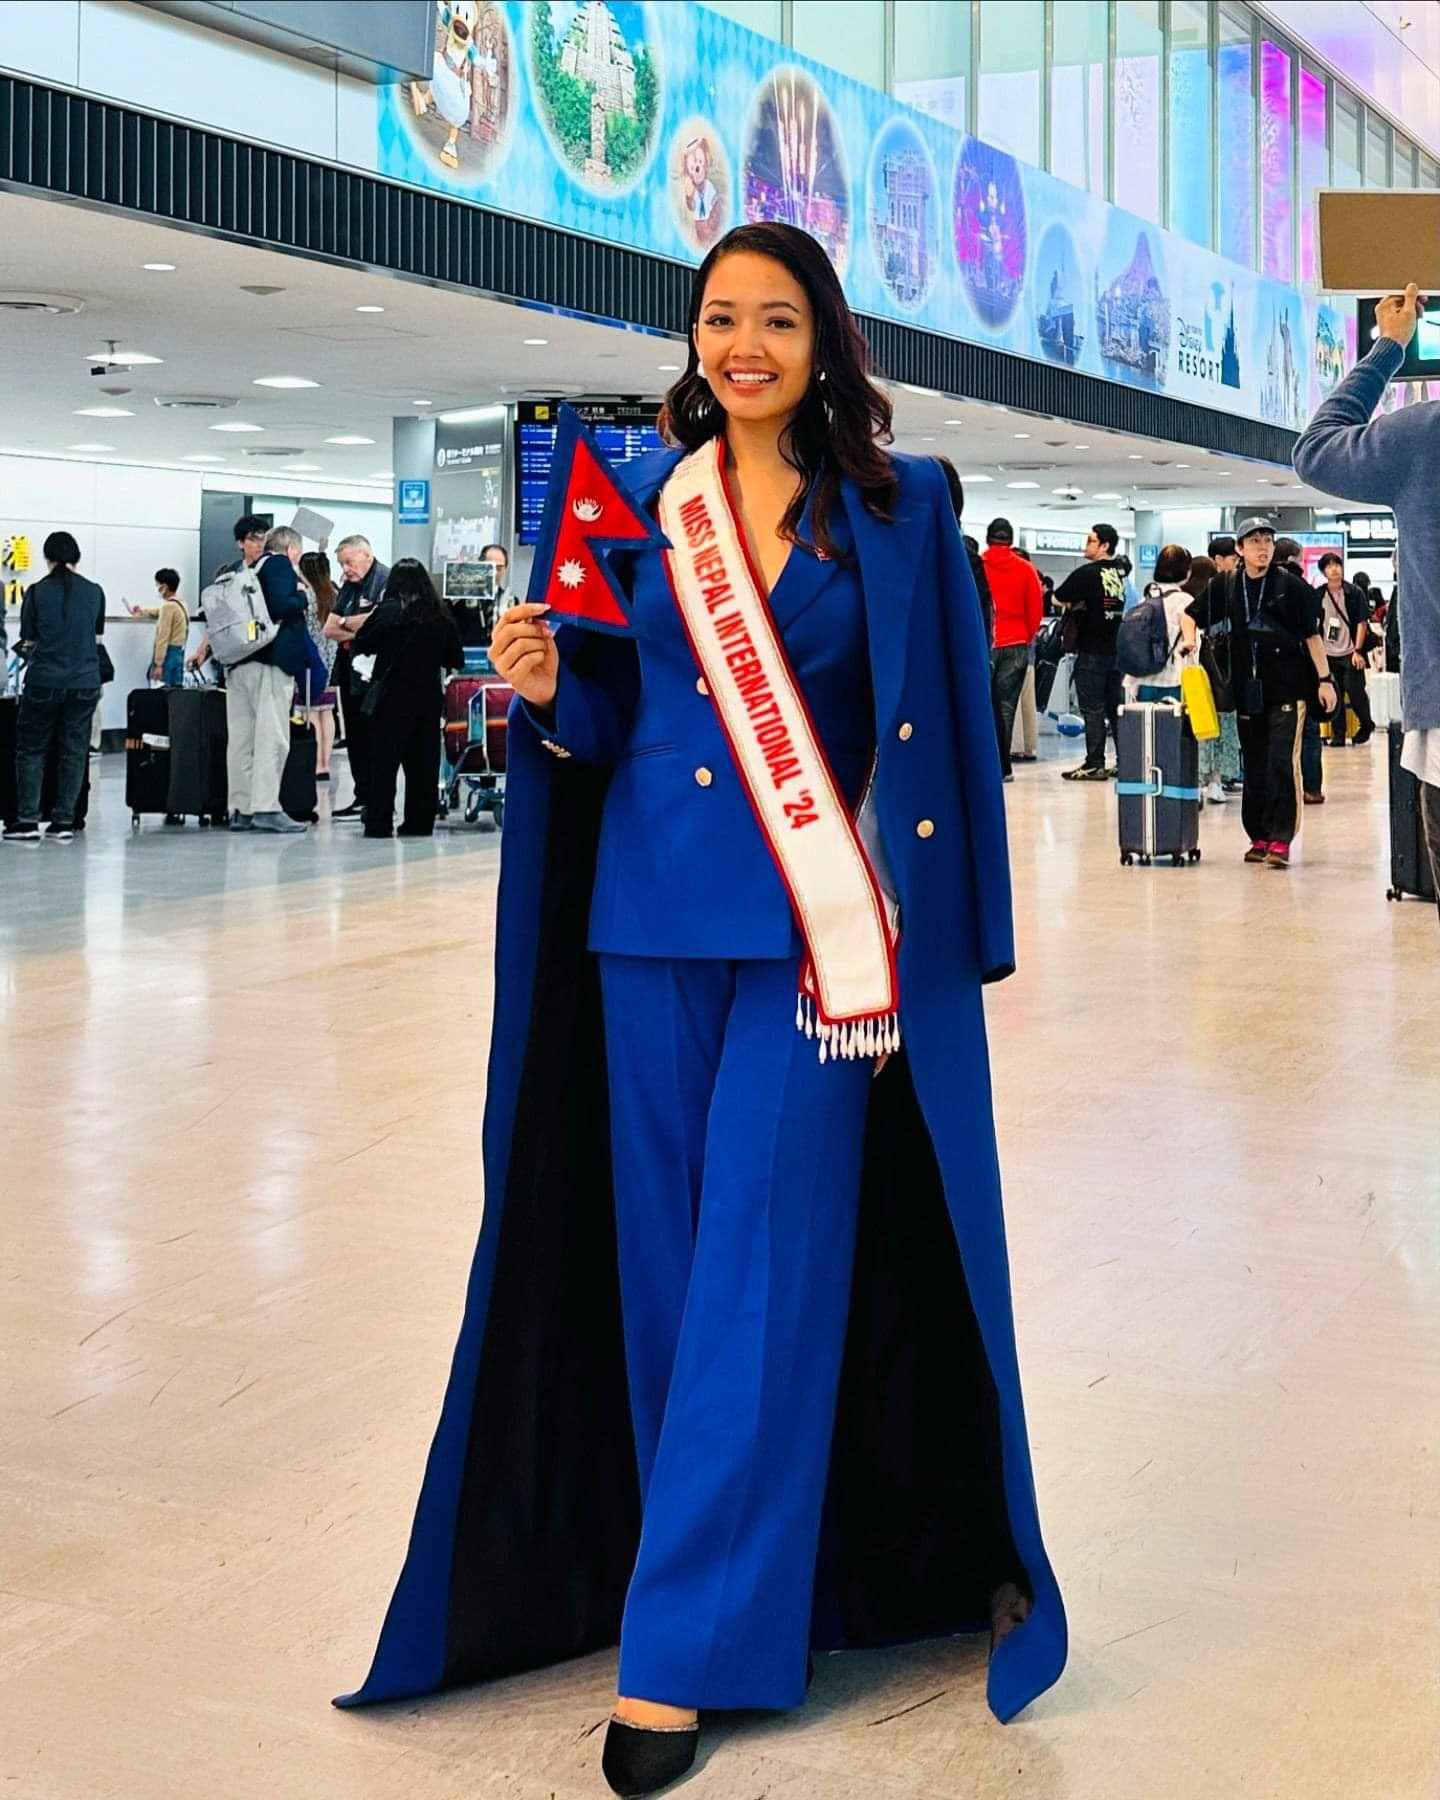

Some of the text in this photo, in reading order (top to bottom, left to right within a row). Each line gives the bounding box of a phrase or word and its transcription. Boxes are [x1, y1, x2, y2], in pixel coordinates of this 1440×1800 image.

[1178, 350, 1220, 384] RESORT
[678, 493, 820, 830] MISS NEPAL INTERNATIONAL '24
